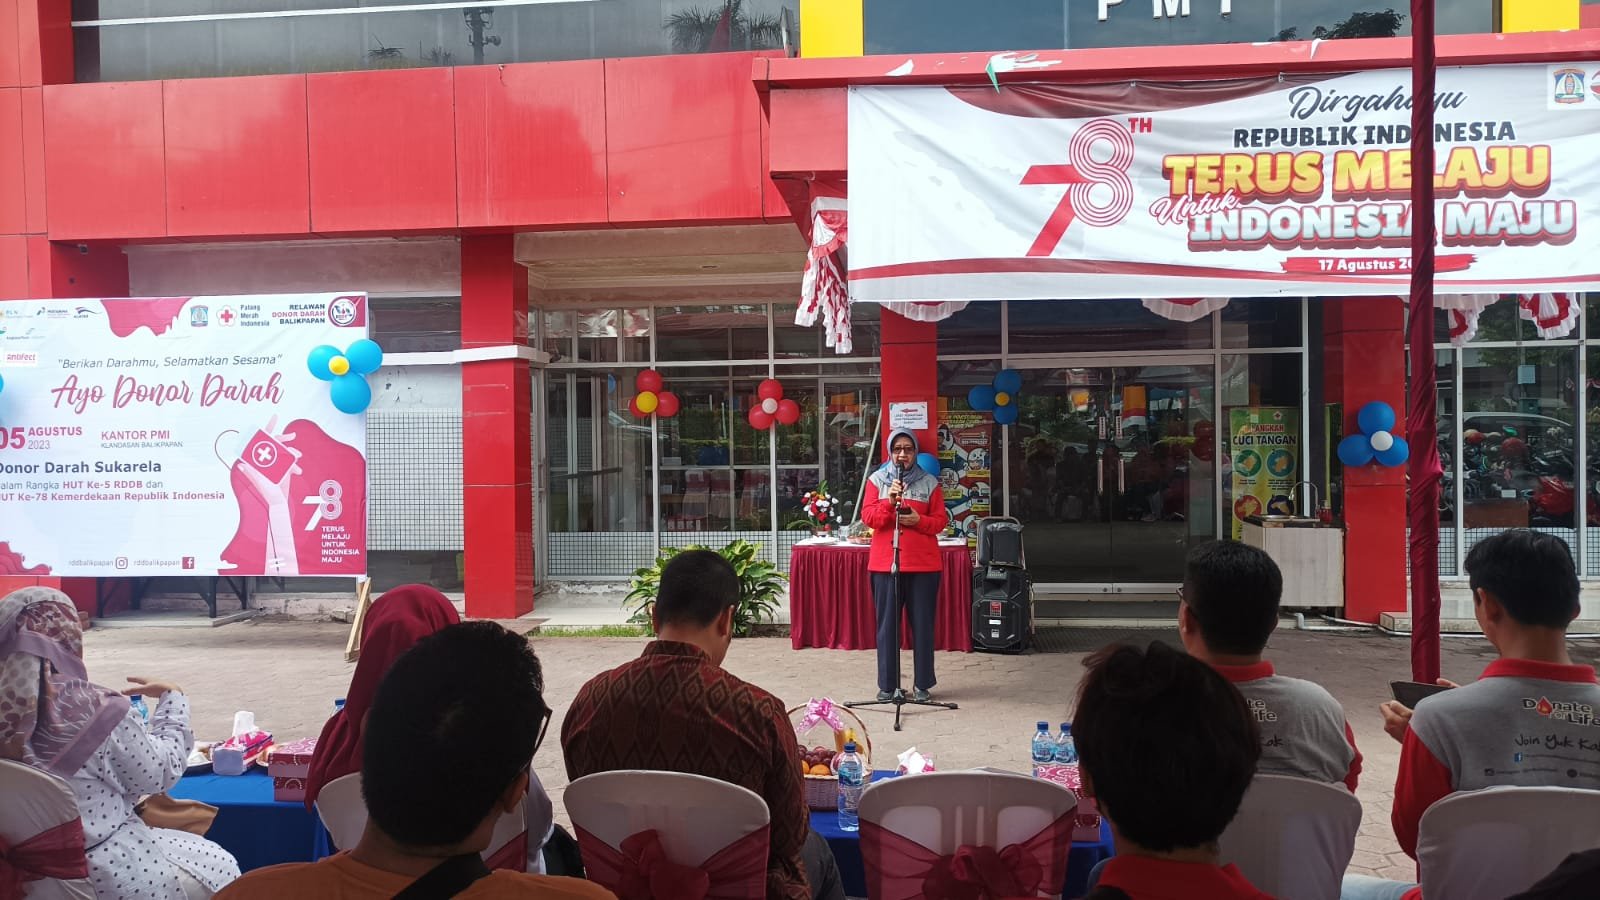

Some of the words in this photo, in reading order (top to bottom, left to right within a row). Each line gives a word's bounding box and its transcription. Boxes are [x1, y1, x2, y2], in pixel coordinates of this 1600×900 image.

[1234, 126, 1357, 148] REPUBLIK
[1363, 121, 1516, 145] INDNESIA
[1163, 152, 1323, 201] TERUS
[1020, 119, 1134, 256] 78
[1128, 118, 1152, 133] TH
[1150, 189, 1239, 224] Untuk
[1443, 200, 1576, 246] MAJU
[1319, 259, 1334, 270] 17
[1337, 259, 1396, 272] Agustus
[106, 358, 159, 369] Darahmu,
[163, 356, 228, 367] Selamatkan
[51, 374, 106, 414] Ayo
[112, 374, 193, 409] Donor
[200, 371, 284, 407] Darah
[28, 427, 82, 437] AGUSTUS
[101, 430, 147, 440] KANTOR
[150, 430, 170, 440] PMI
[28, 440, 50, 449] 2023
[1232, 435, 1254, 446] CUCI
[1257, 434, 1297, 445] TANGAN
[45, 461, 89, 473] Darah
[94, 460, 162, 473] Sukarela
[0, 481, 23, 490] alam
[26, 481, 59, 491] Rangka
[63, 480, 83, 489] HUT
[87, 480, 110, 488] Ke-5
[114, 480, 143, 488] RDDB
[146, 480, 163, 488] dan
[0, 492, 14, 501] UT
[18, 492, 48, 501] Ke-78
[51, 492, 121, 501] Kemerdekaan
[124, 491, 169, 502] Republik
[172, 491, 225, 500] Indonesia
[302, 480, 342, 531] 78
[1515, 735, 1540, 746] Join
[1578, 738, 1600, 752] Ka
